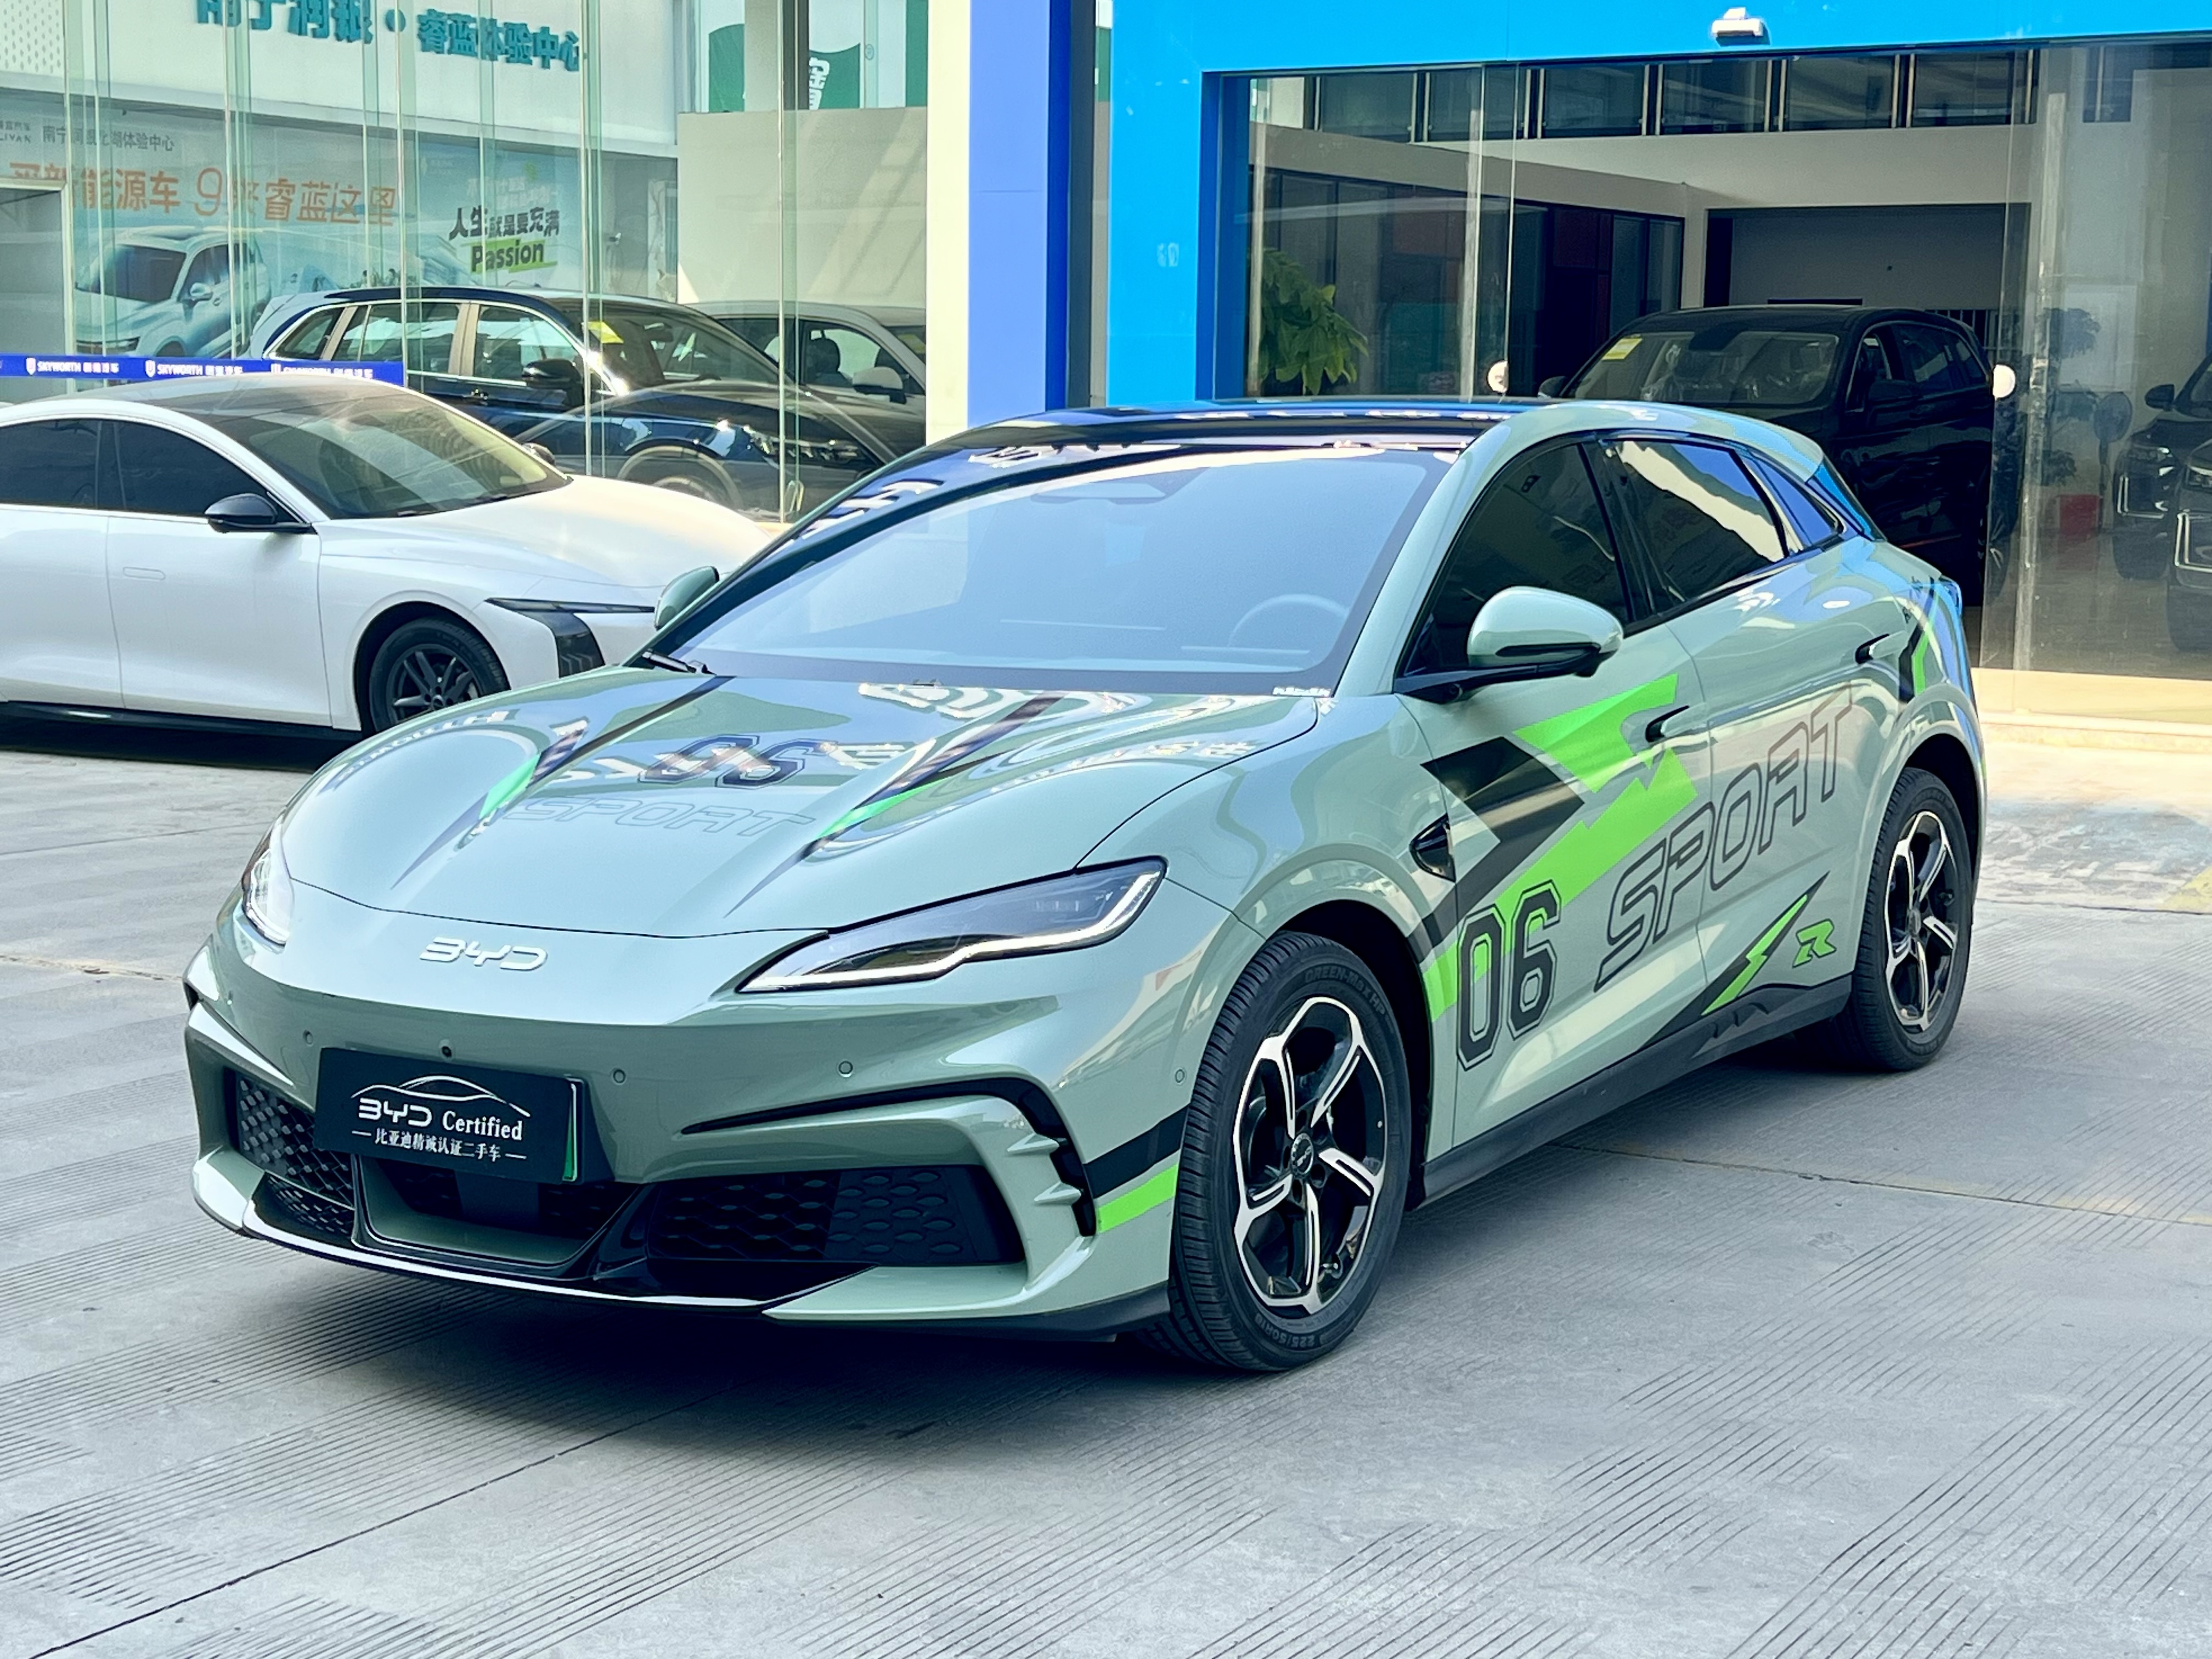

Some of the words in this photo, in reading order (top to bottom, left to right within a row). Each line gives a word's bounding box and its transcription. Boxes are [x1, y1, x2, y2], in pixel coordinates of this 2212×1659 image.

[472, 239, 544, 272] Passion
[503, 797, 816, 837] SPORT
[1594, 681, 1852, 992] SPORT
[419, 936, 548, 972] BYD
[1456, 879, 1561, 1071] 06
[358, 1098, 432, 1127] BYD
[442, 1110, 523, 1141] Certified
